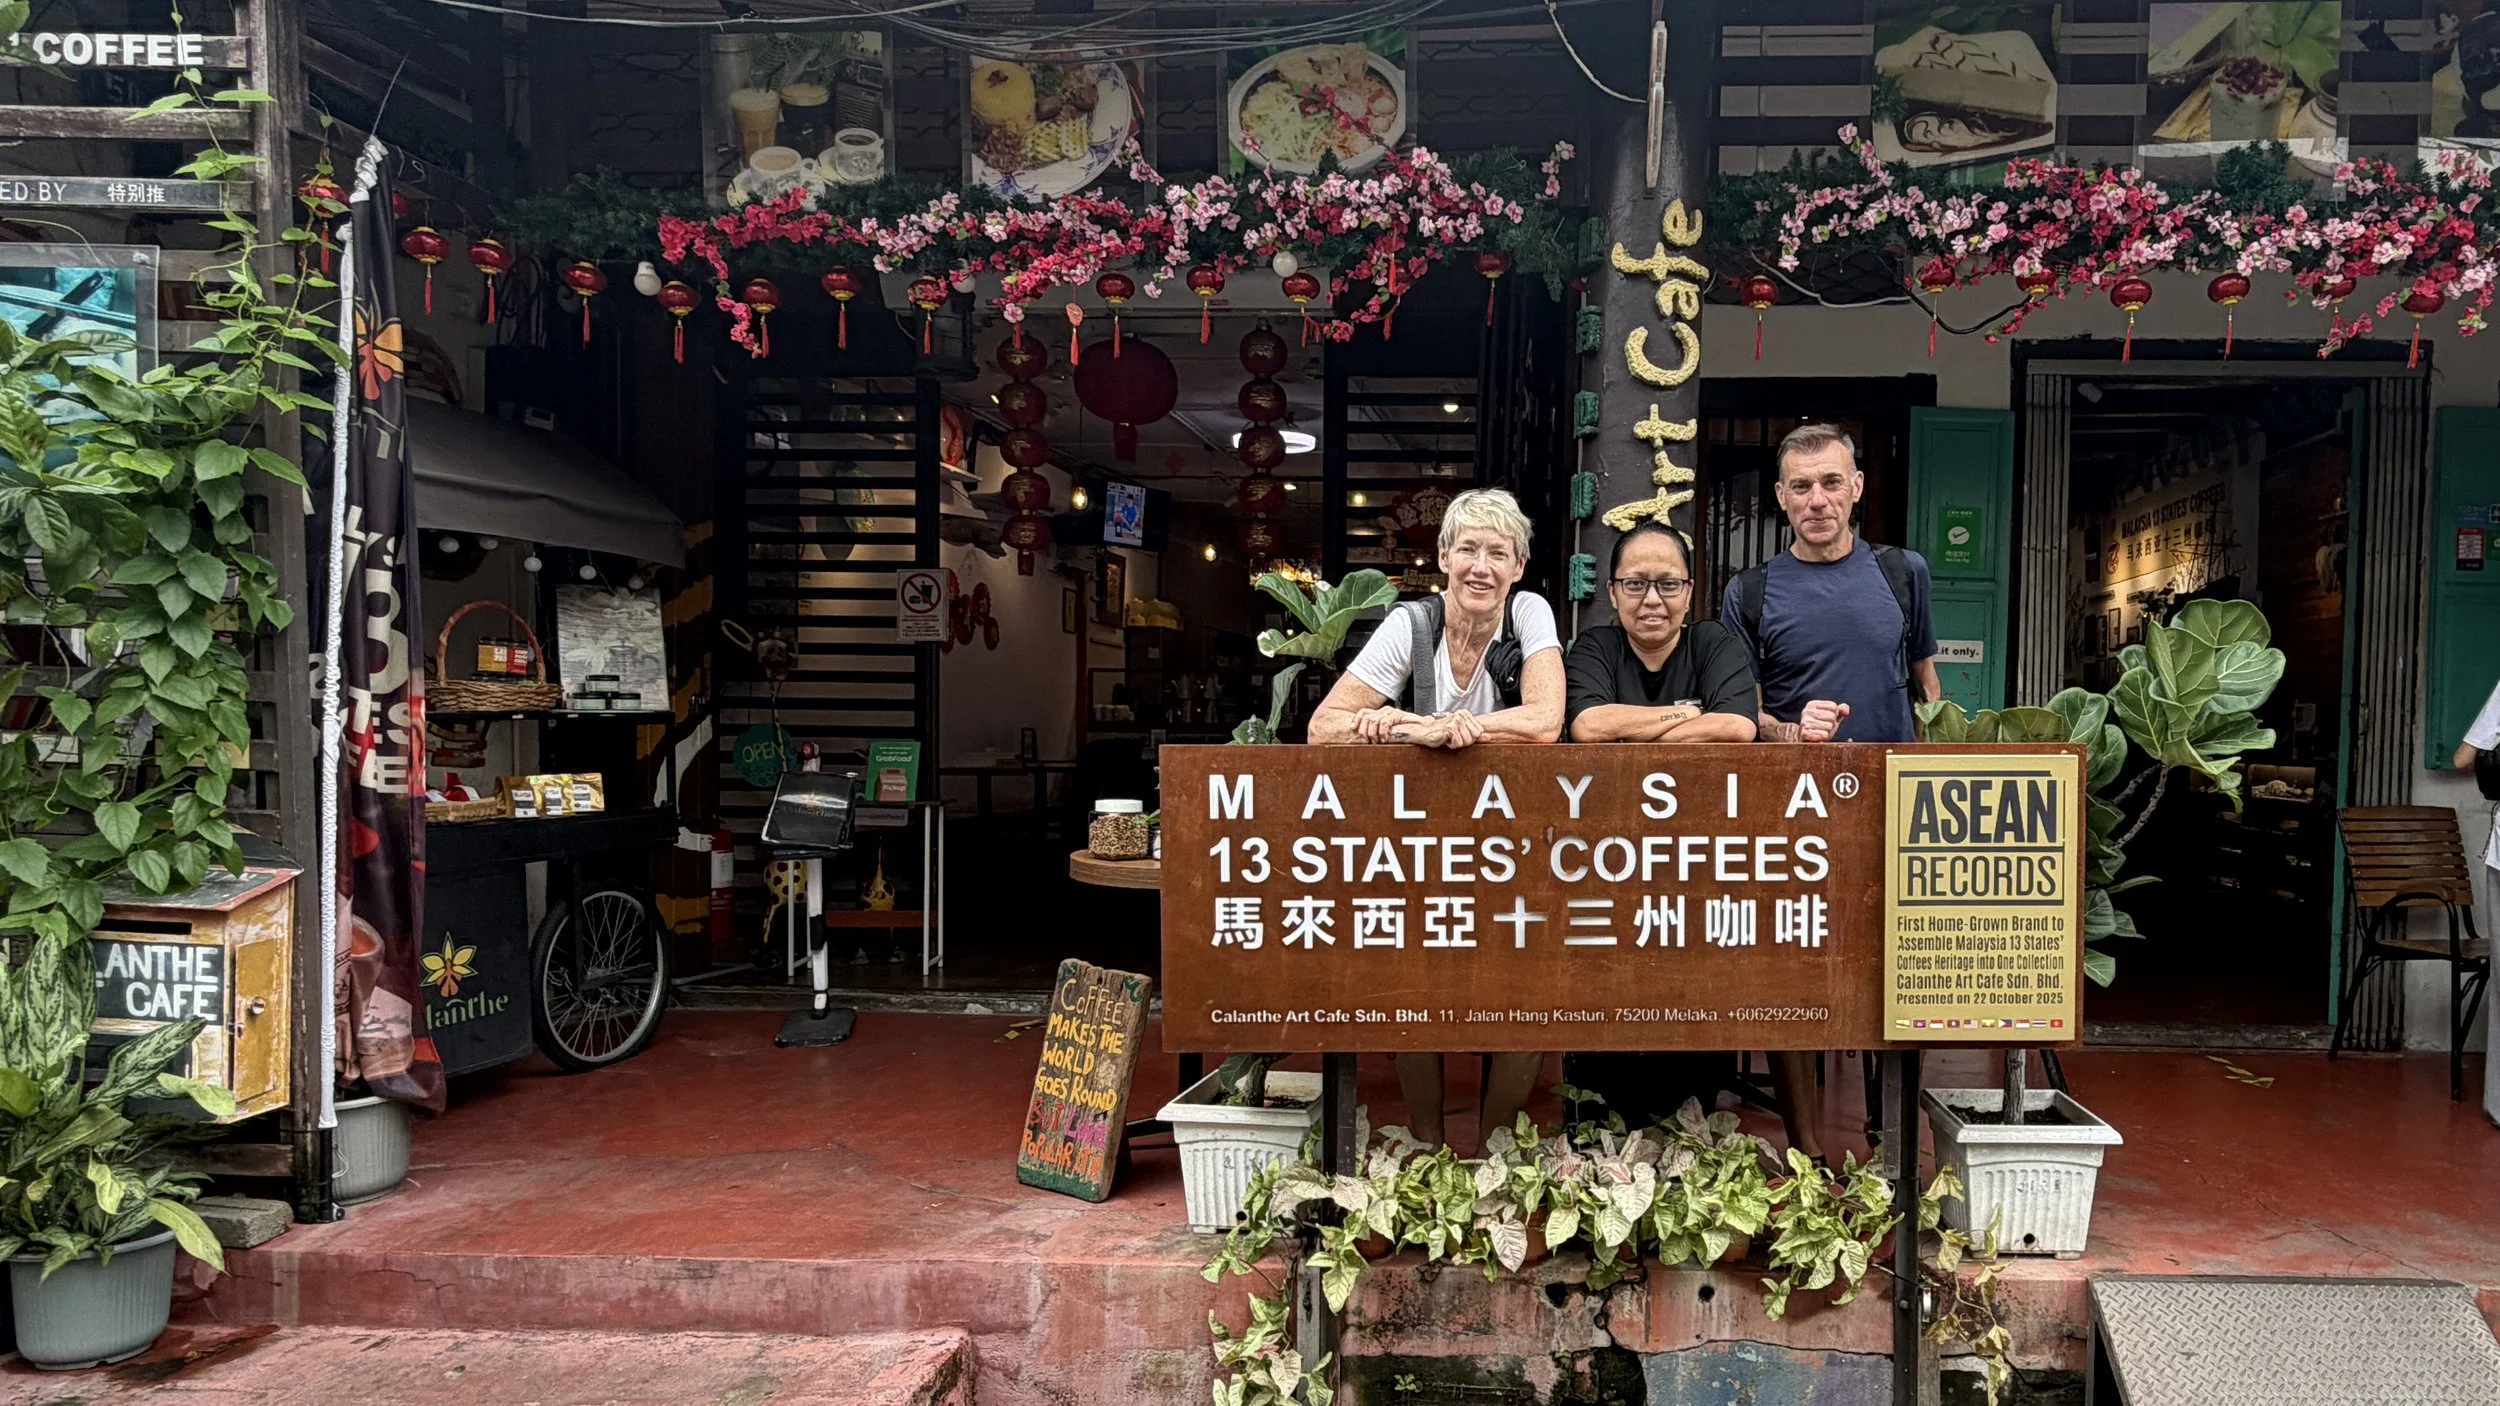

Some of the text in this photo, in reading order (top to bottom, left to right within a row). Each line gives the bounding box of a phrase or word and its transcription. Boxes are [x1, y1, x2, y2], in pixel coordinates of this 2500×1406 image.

[33, 32, 204, 66] COFFEE
[39, 182, 67, 202] BY
[1602, 198, 1710, 552] Art Cafe
[2152, 509, 2160, 527] 13
[1938, 646, 1979, 658] it only.
[742, 741, 784, 763] OPEN
[876, 755, 913, 763] GrabFood
[1908, 780, 2057, 844] ASEAN
[1209, 835, 1830, 883] 13 STATES' COFFEES
[1907, 855, 2056, 897] RECORDS
[1211, 894, 1829, 950] 馬來西亞十三州咖啡
[1897, 916, 2064, 932] First Home-Grown Brand to
[1897, 935, 1953, 951] Assemble
[1955, 935, 2006, 953] Malaysia
[2009, 935, 2021, 951] 13
[96, 943, 219, 983] ANTHE
[1896, 953, 2064, 972] Coffees Heritage into One Collection
[1896, 973, 2064, 990] Calanthe Art Cafe Sdn. Bhd.
[126, 981, 218, 1021] CAFE
[1896, 992, 2063, 1005] Presented on 22 October 2025
[1211, 1009, 1282, 1023] Calanthe
[1285, 1009, 1310, 1023] Art
[1314, 1009, 1350, 1023] Cafe
[1355, 1009, 1391, 1023] Sdn.
[1396, 1009, 1432, 1023] Bhd.
[1438, 1010, 1460, 1024] 11,
[1464, 1009, 1504, 1023] Jalan
[1509, 1009, 1549, 1025] Hang
[1614, 1008, 1660, 1021] 75200
[1727, 1007, 1829, 1021] +6062922960
[1047, 1012, 1125, 1055] MAKES THE
[1043, 1040, 1095, 1075] WORLD
[1036, 1066, 1118, 1111] GOES ROUND
